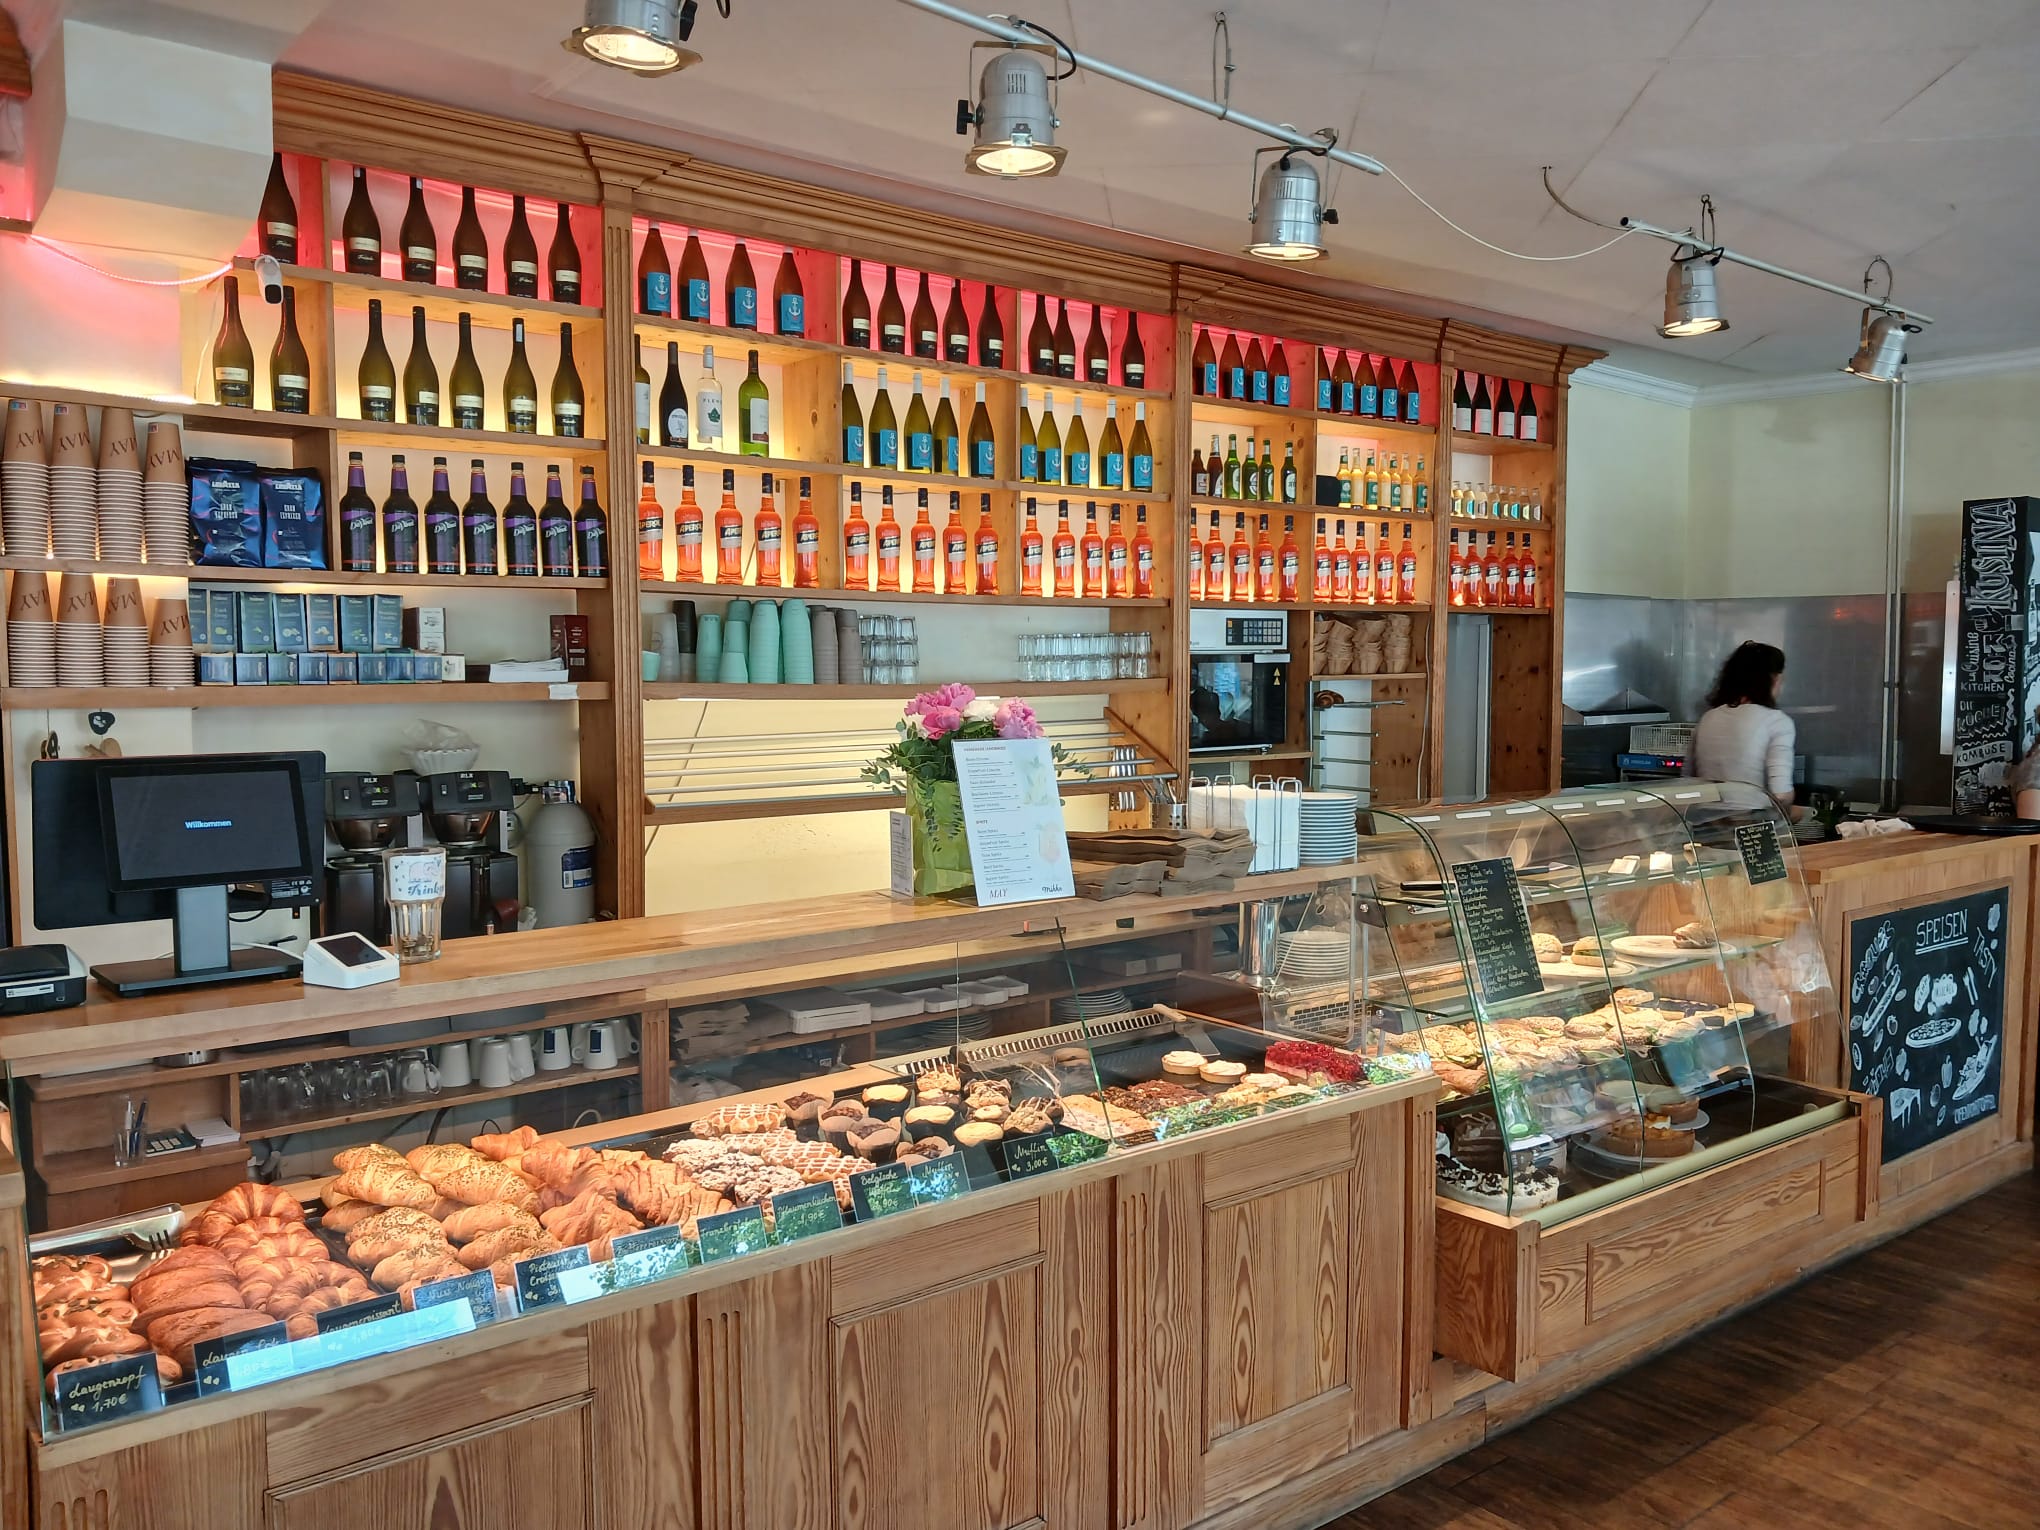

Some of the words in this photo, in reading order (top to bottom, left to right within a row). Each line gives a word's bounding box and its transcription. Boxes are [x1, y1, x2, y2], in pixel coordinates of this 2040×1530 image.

[185, 819, 232, 829] Willkommen
[1917, 909, 1968, 947] SPEISEN
[1974, 926, 1998, 988] TASTY
[1014, 1141, 1047, 1161] Muffin
[69, 1365, 147, 1401] Laugenzopf
[91, 1393, 128, 1414] 1,70€
